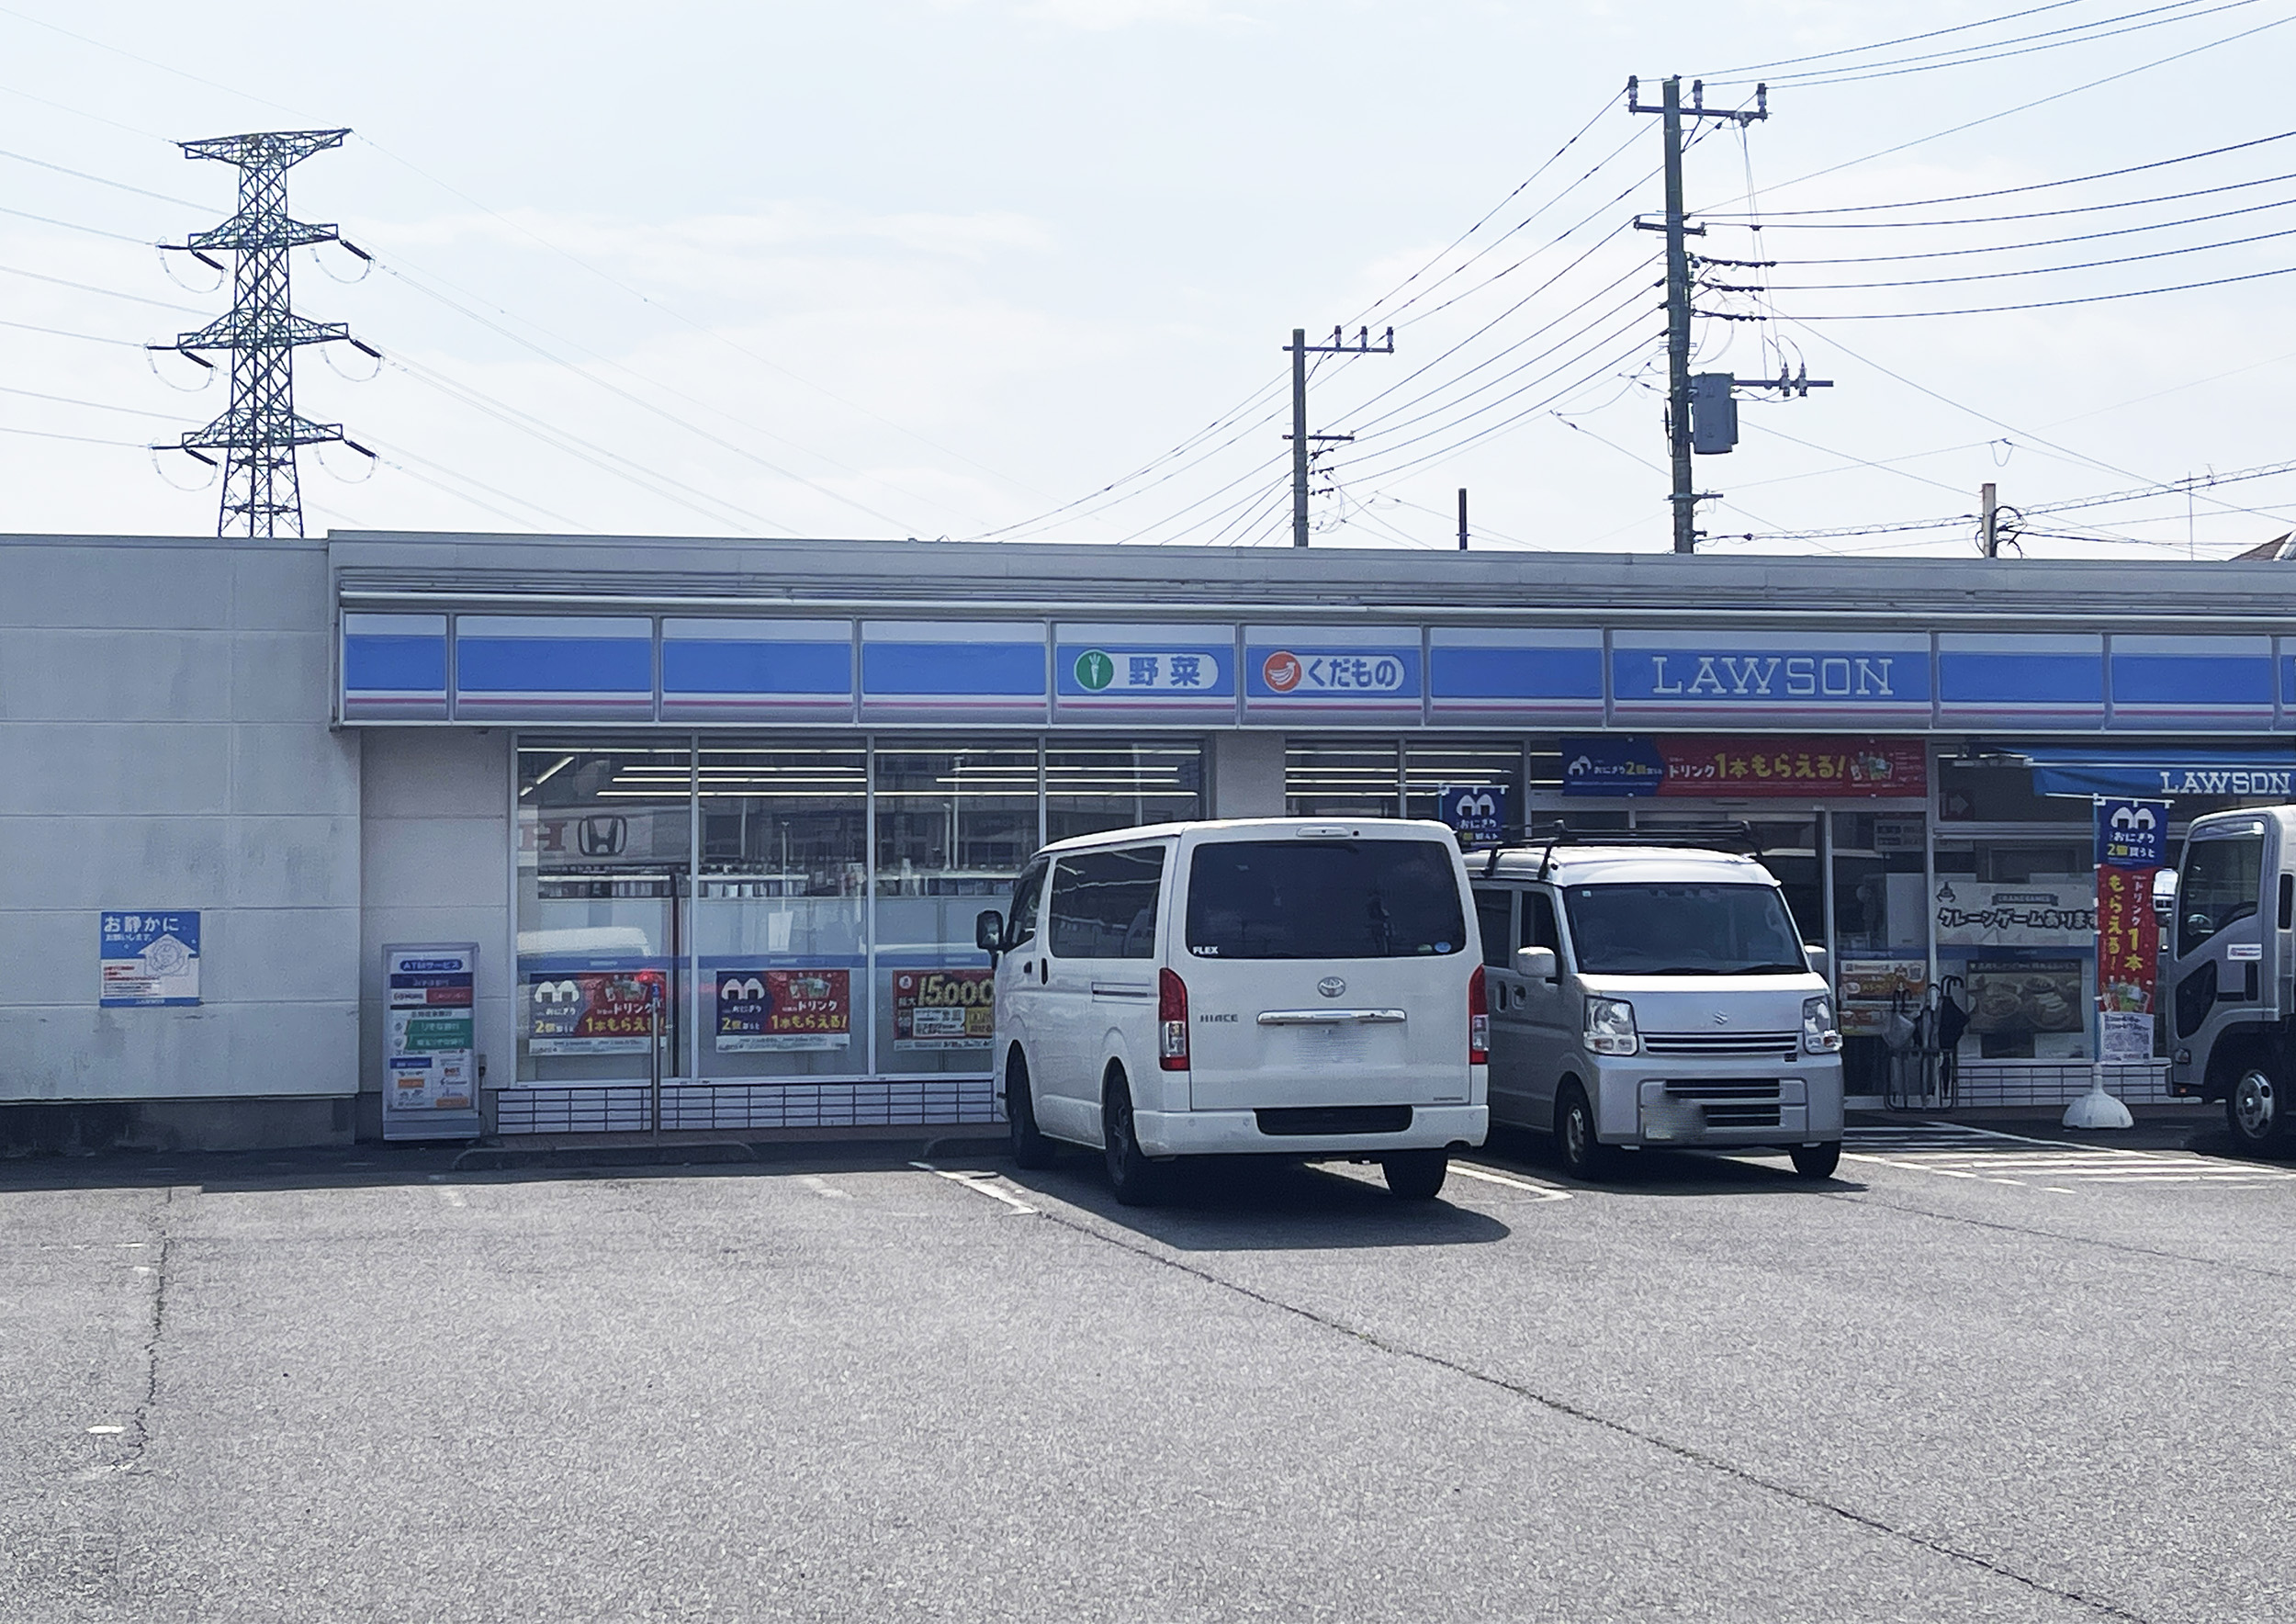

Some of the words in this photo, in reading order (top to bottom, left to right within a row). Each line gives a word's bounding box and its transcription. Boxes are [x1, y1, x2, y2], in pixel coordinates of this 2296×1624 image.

[1129, 656, 1201, 686] 野菜
[1307, 658, 1397, 688] くだもの
[1651, 656, 1895, 695] LAWSON
[2159, 771, 2292, 795] LAWSON
[2113, 831, 2155, 843] おにぎり
[104, 916, 179, 933] お静かに
[1193, 946, 1219, 954] FLEX
[798, 999, 838, 1011] ドリンク
[771, 1014, 848, 1031] 1本もらえる!
[1200, 1014, 1239, 1022] HIACE
